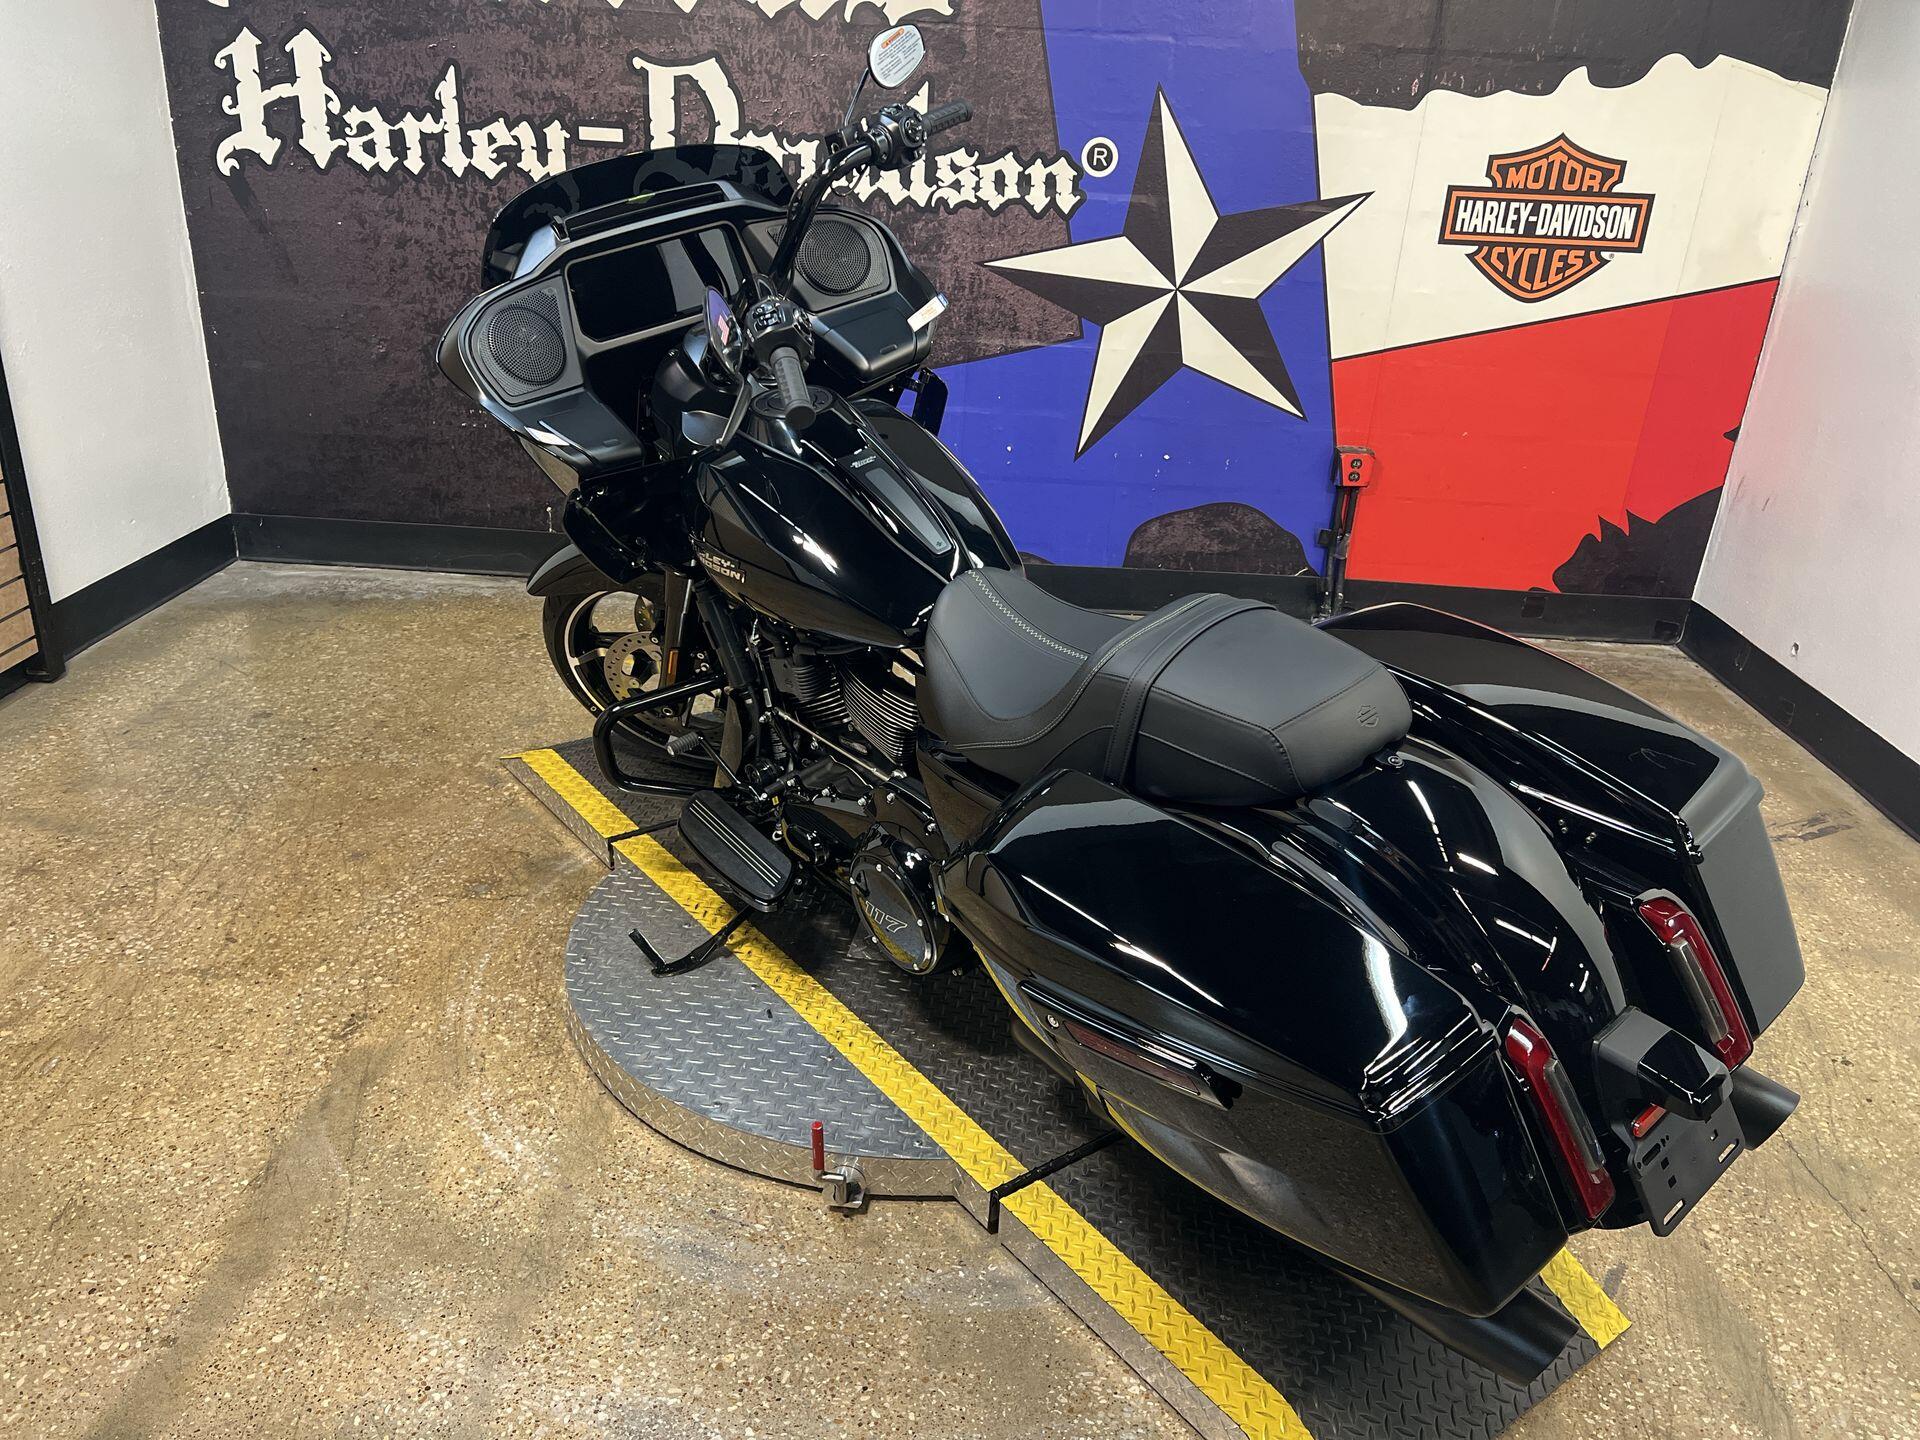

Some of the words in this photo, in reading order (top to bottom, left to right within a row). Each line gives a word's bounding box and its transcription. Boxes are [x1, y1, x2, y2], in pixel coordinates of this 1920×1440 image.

[1506, 151, 1602, 192] MOTOR
[1455, 199, 1637, 240] HARLEY-DAVIDSON
[1490, 246, 1584, 291] CYCLES
[865, 900, 908, 934] 117
